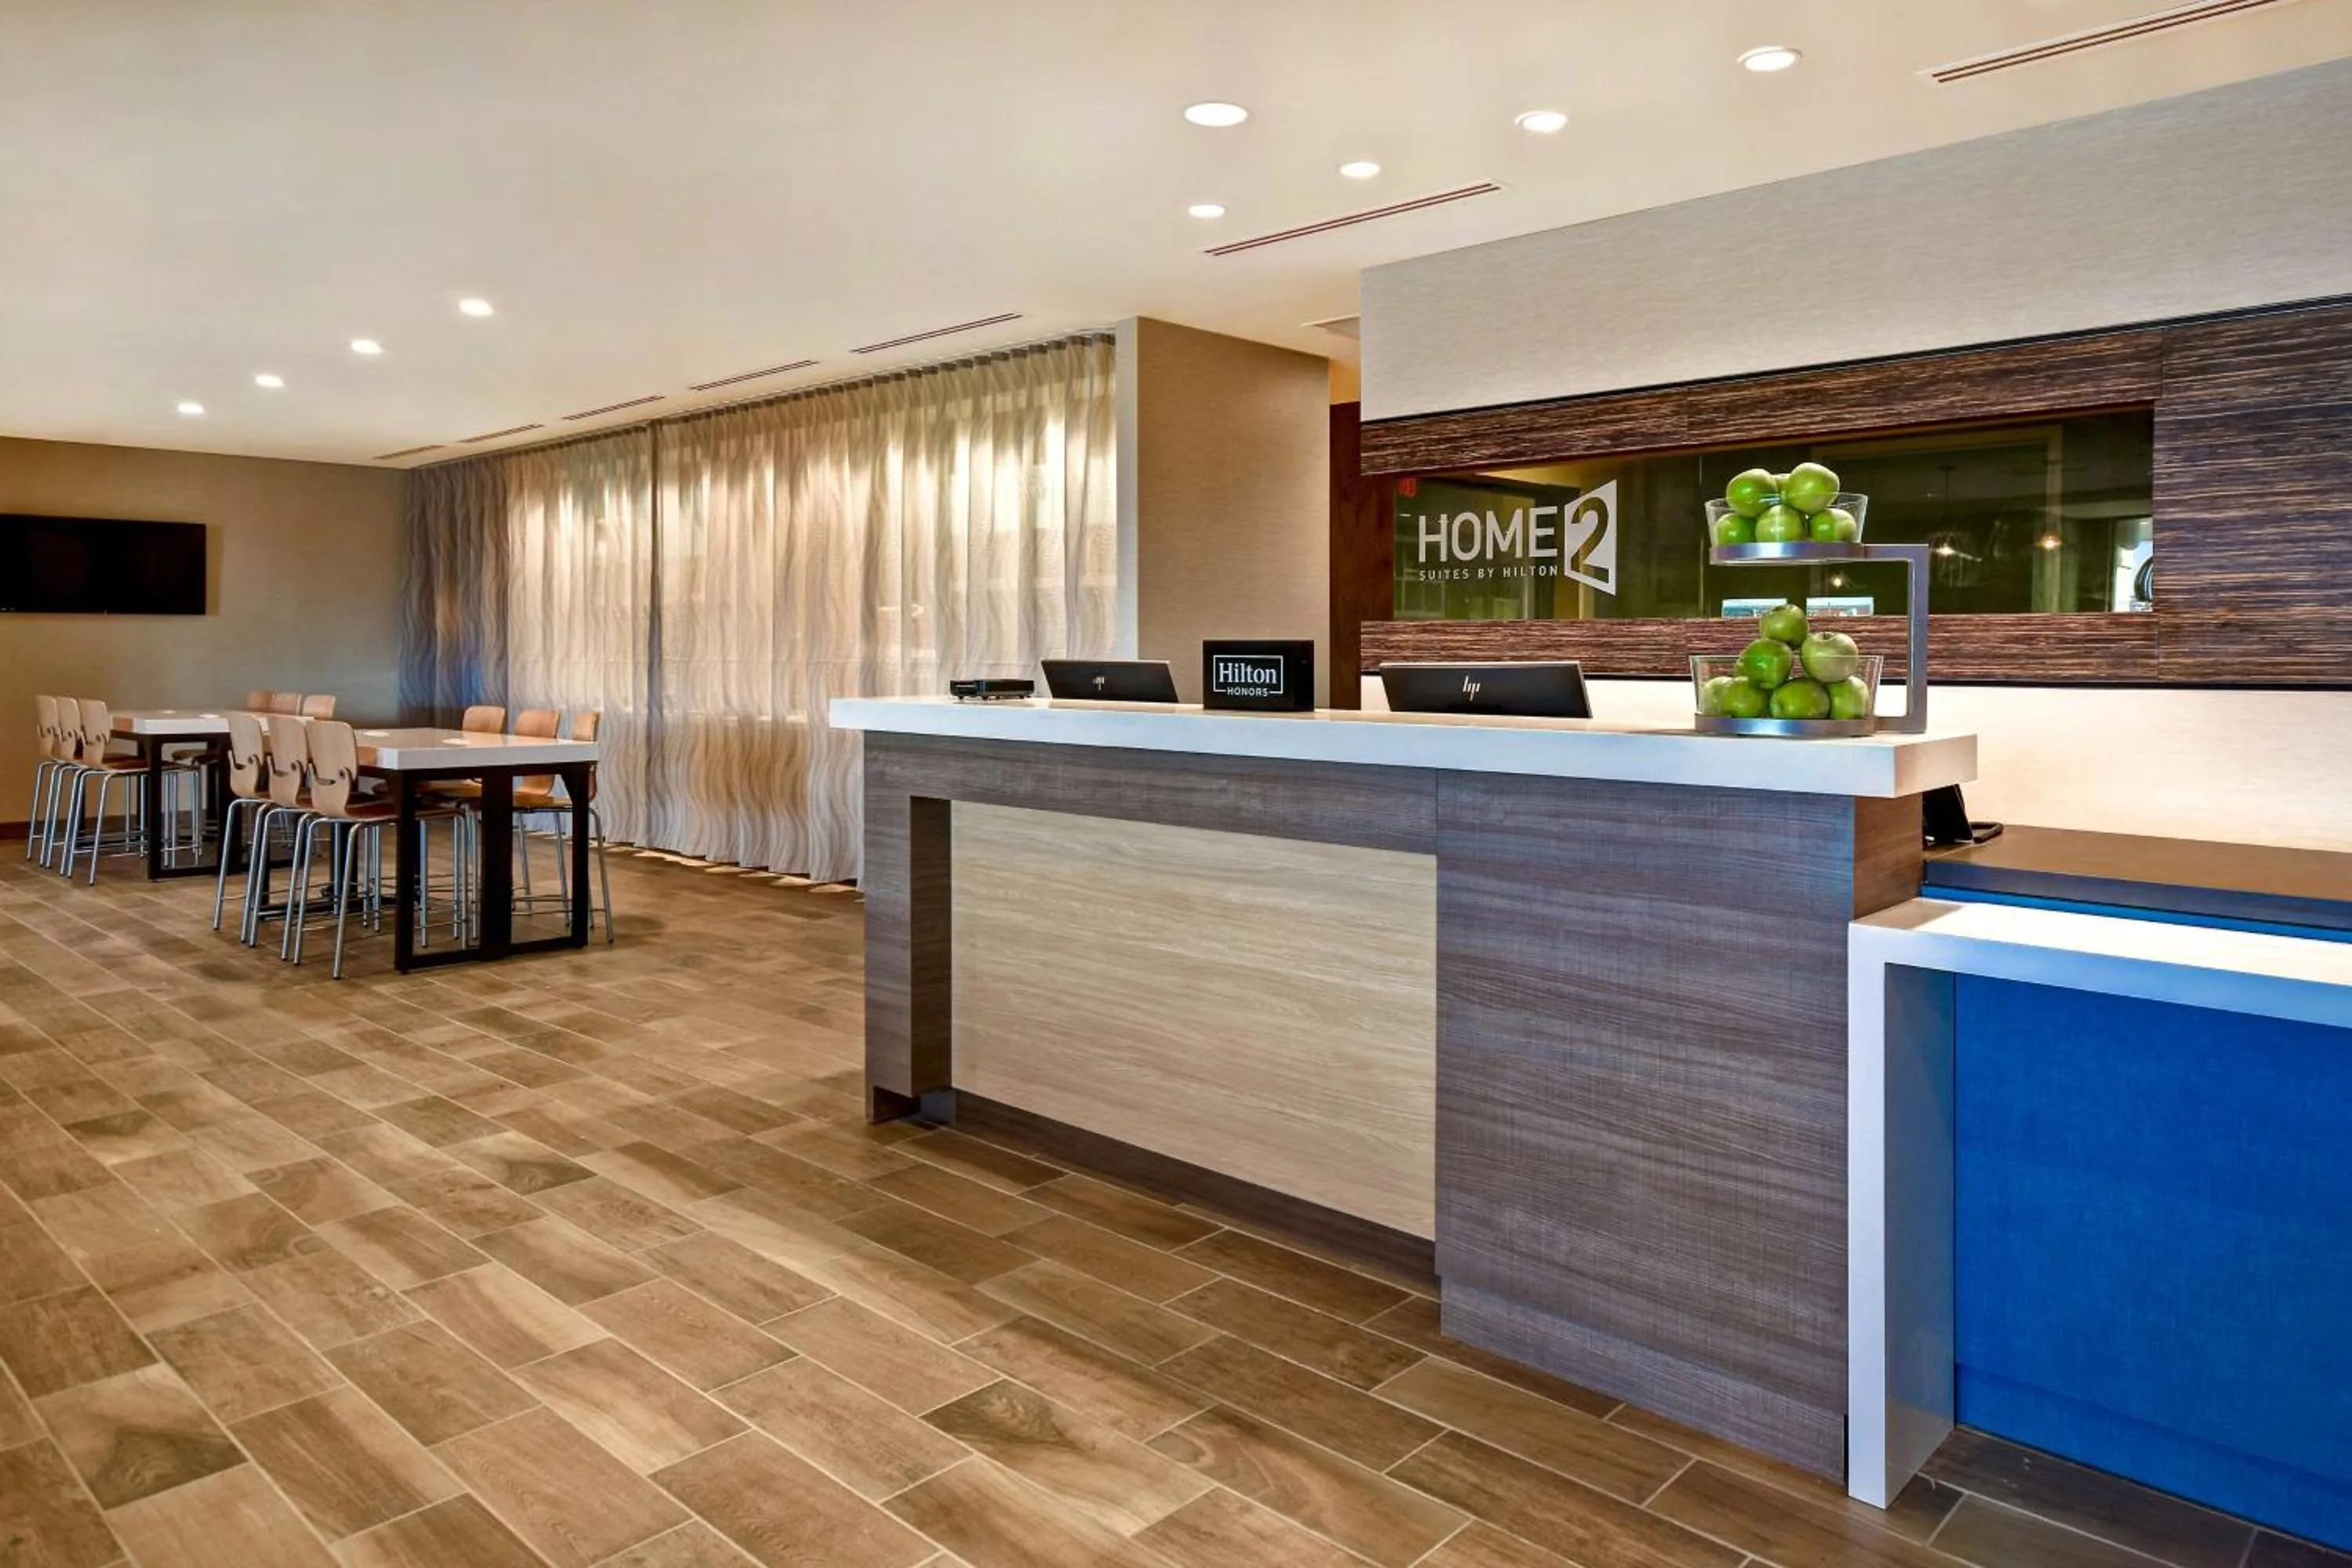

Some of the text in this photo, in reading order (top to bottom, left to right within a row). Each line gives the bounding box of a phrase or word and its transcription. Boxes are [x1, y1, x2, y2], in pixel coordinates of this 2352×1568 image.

[1418, 506, 1558, 564] HOME
[1419, 565, 1558, 582] SUITES BY HILTON
[1218, 662, 1276, 684] Hilton
[1227, 687, 1269, 697] HONORS
